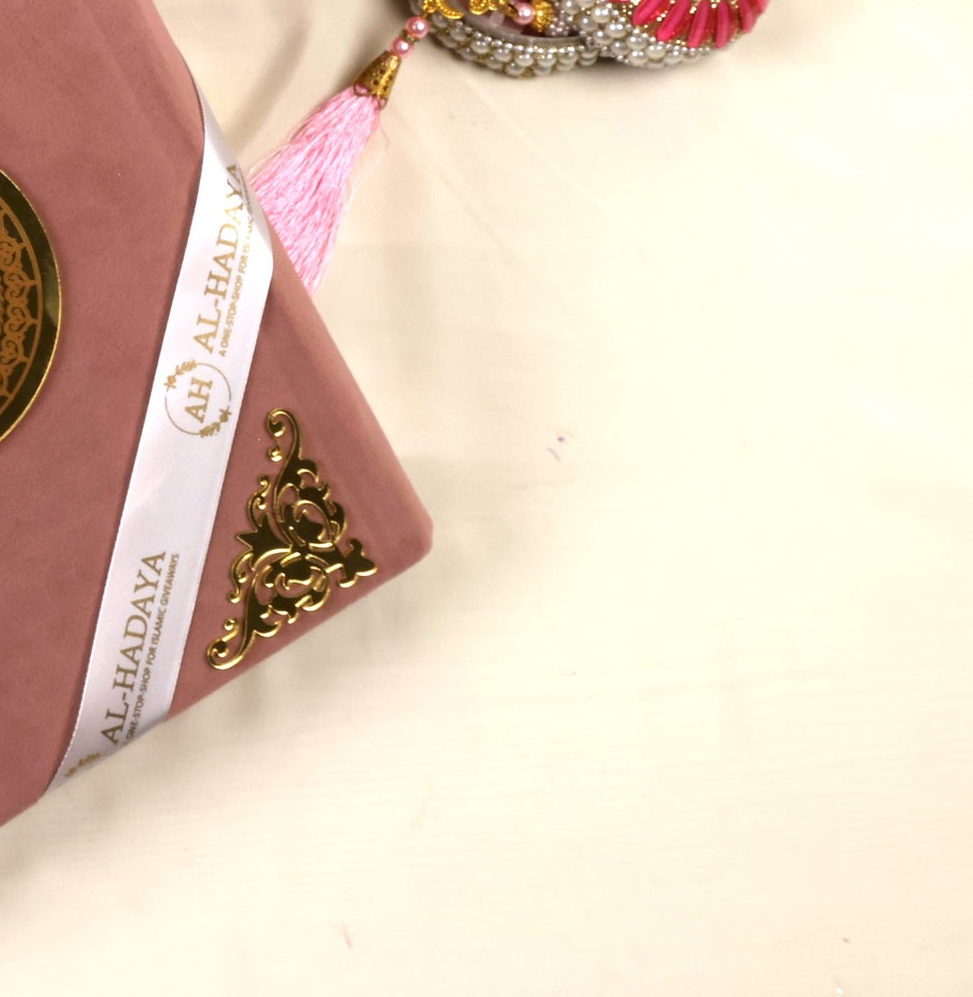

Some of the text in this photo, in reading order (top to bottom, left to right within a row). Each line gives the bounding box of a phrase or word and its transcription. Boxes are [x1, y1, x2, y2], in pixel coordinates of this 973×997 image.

[183, 376, 214, 424] AH
[159, 553, 180, 606] GIVEAWAYS
[100, 551, 167, 746] AL-HADAYA
[151, 606, 167, 645] ISLAMIC
[146, 646, 157, 666] FOR
